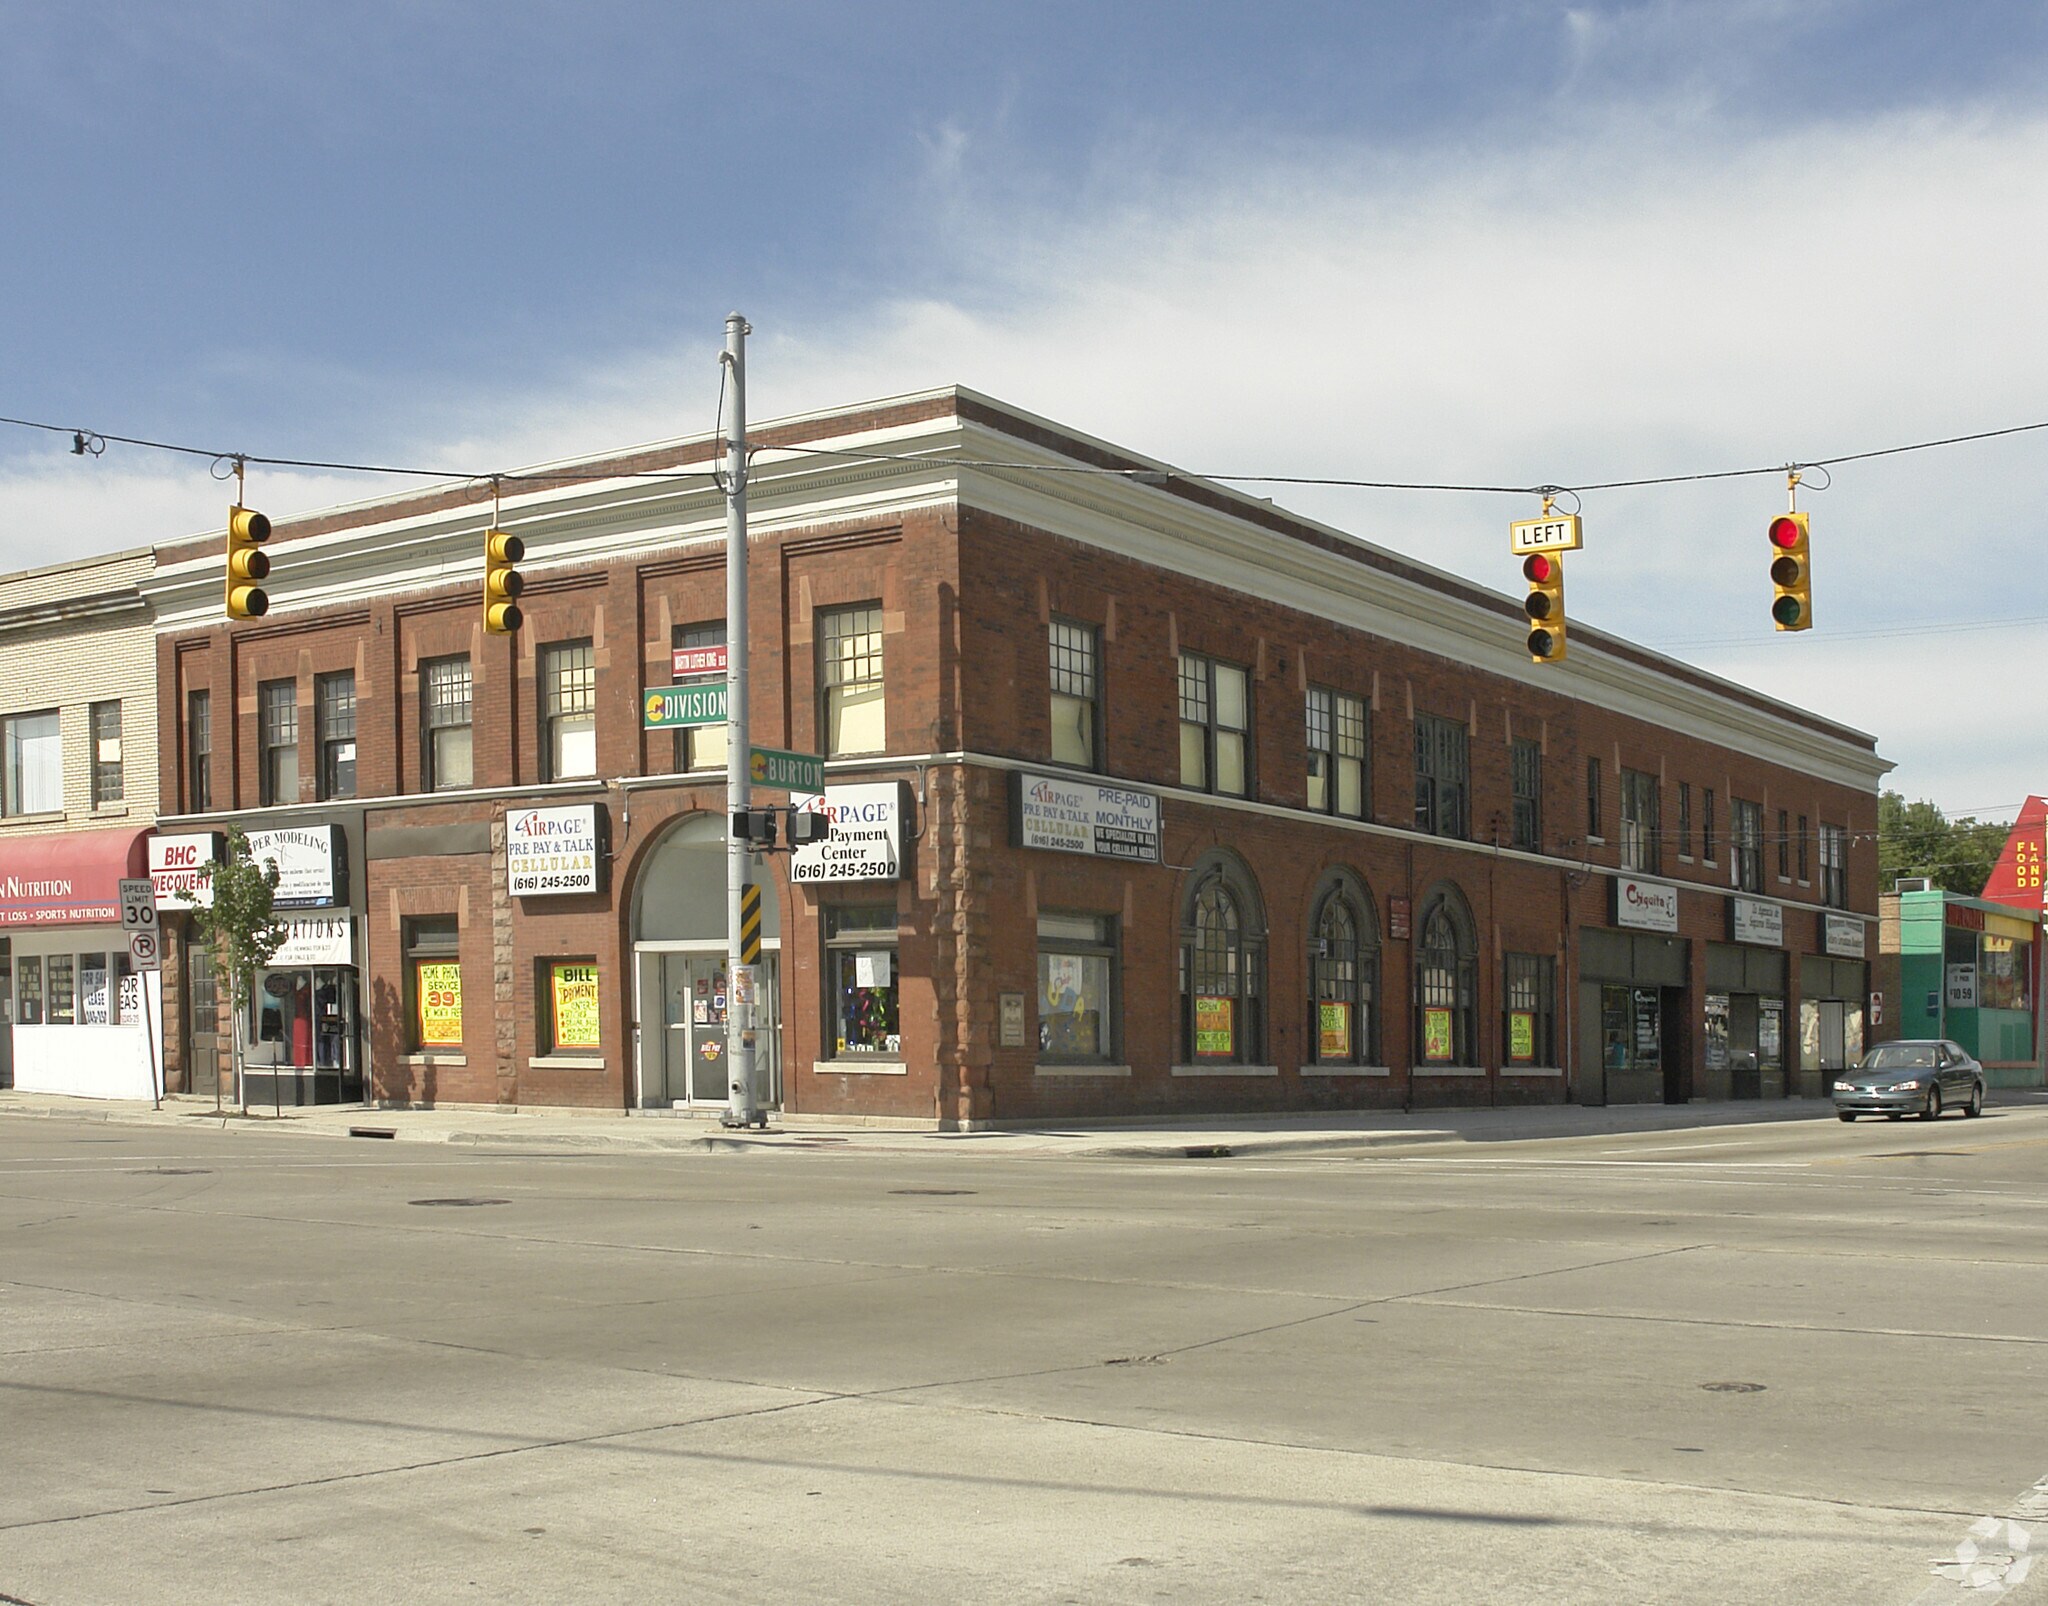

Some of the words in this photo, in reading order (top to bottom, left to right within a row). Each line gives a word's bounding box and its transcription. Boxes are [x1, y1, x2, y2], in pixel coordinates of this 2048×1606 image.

[1522, 523, 1565, 545] LEFT
[664, 691, 727, 720] DIVISION
[768, 756, 823, 788] BURTON
[1098, 788, 1151, 809] PRE-PAID
[1023, 802, 1041, 816] PRE
[1043, 806, 1059, 819] PAY
[1066, 809, 1090, 824] TALK
[1121, 806, 1129, 815] &
[1025, 818, 1089, 839] CELLULAR
[1095, 810, 1153, 831] MONTHLY
[274, 831, 328, 854] MODELING
[830, 828, 888, 846] Payment
[1031, 834, 1049, 848] (616)
[1050, 837, 1084, 850] 245-2500
[164, 845, 197, 866] BHC
[509, 842, 529, 856] PRE
[533, 841, 551, 854] PAY
[553, 841, 561, 853] &
[563, 838, 594, 852] TALK
[821, 845, 867, 860] Center
[511, 855, 593, 873] CELLULAR
[794, 862, 826, 879] (616)
[7, 877, 72, 898] NUTRITION
[123, 885, 151, 893] SPEED
[514, 876, 538, 890] (616)
[126, 895, 149, 903] LIMIT
[1626, 884, 1665, 909] Chiquita
[8, 911, 27, 921] LOSS
[36, 909, 67, 920] SPORTS
[70, 908, 115, 919] NUTRITION
[126, 906, 153, 924] 30
[423, 966, 439, 979] HOME
[564, 968, 592, 982] BILL
[428, 981, 458, 991] SERVICE
[563, 985, 595, 1003] PAYMENT
[88, 991, 105, 1006] LEASE
[428, 991, 454, 1007] 39
